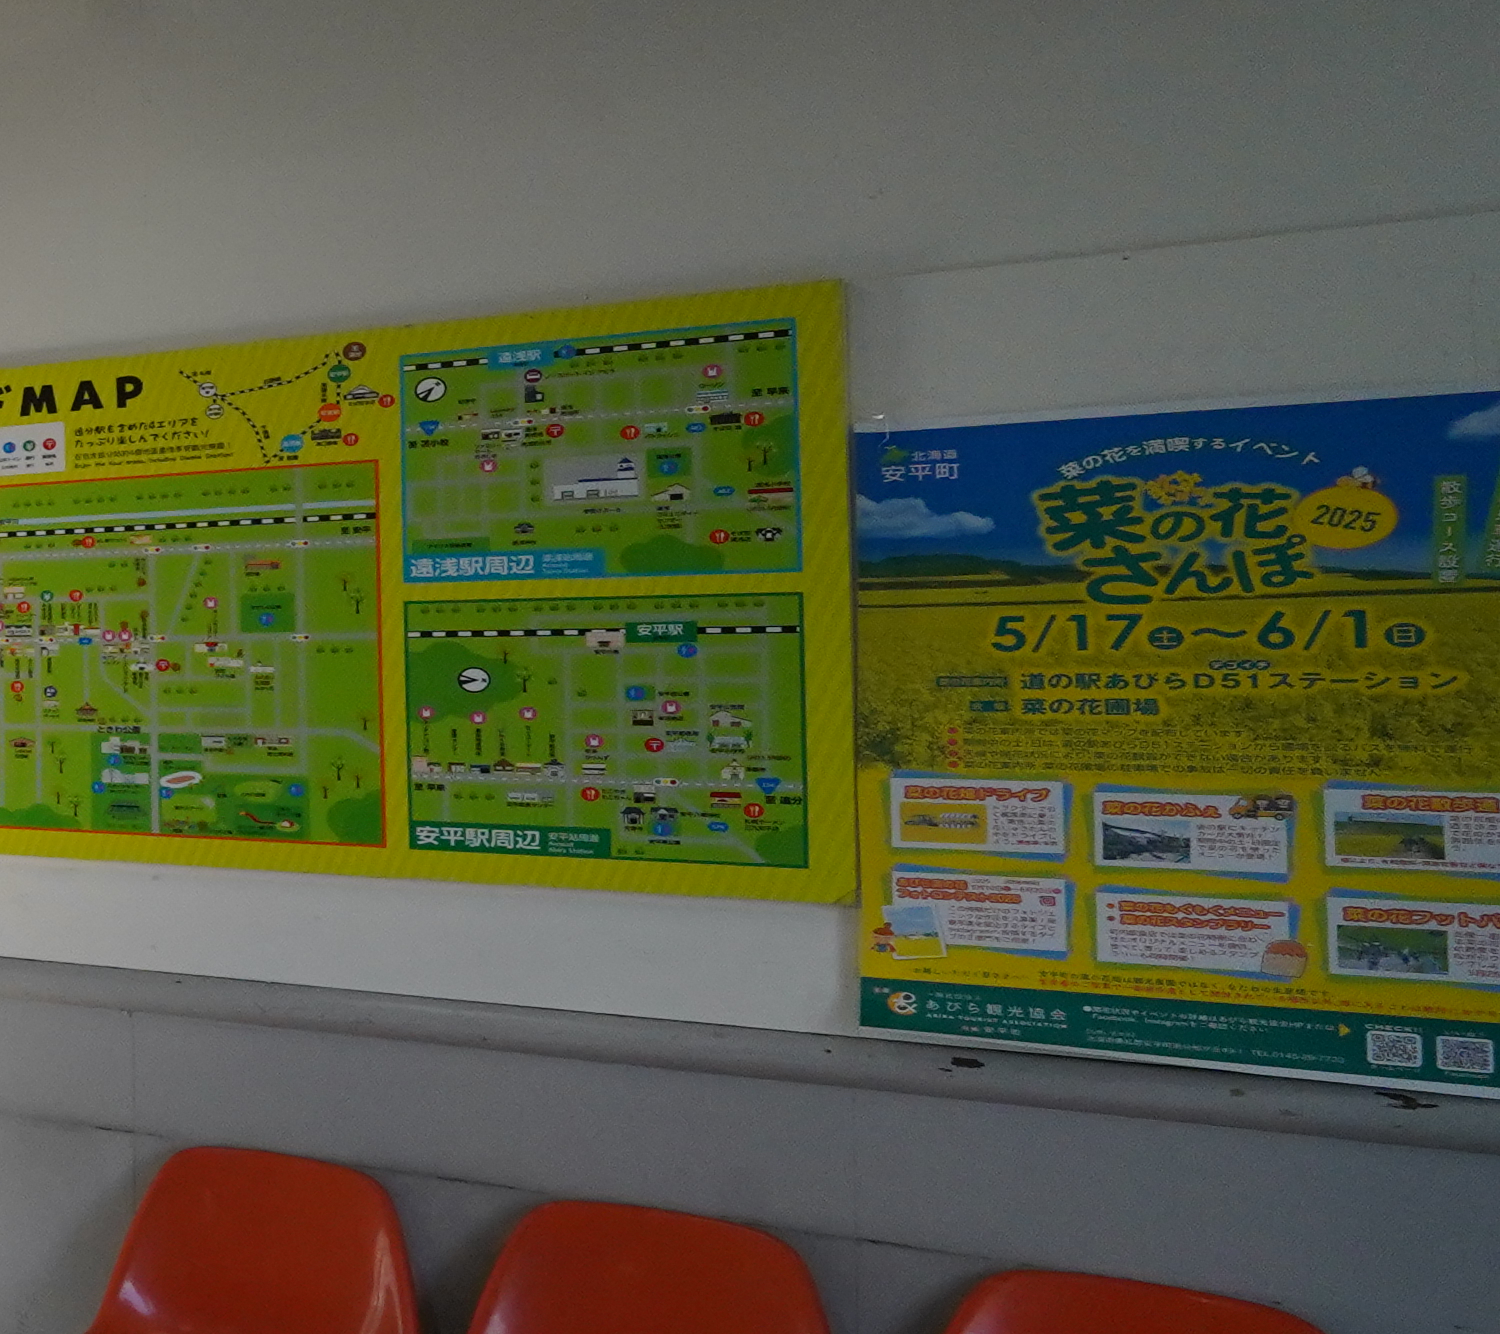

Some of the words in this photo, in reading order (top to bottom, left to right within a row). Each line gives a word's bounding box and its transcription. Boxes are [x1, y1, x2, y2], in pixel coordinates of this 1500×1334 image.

[497, 348, 542, 364] 遠浅駅
[911, 449, 957, 462] 北海道
[1058, 436, 1320, 481] 菜の花を満喫するイベント
[881, 463, 960, 483] 安平町
[1036, 479, 1294, 553] 菜の花
[1311, 504, 1381, 532] 2025
[1438, 480, 1463, 583] 散歩コース設置
[410, 555, 535, 578] 遠浅駅周辺
[1083, 532, 1316, 606] さんぽ
[636, 624, 684, 636] 安平駅
[1020, 670, 1460, 692] 道の駅あびらD51ステーション
[1102, 800, 1223, 819] 菜の花かふぇ
[416, 825, 541, 850] 安平駅周辺
[925, 999, 1067, 1021] あびら観光協会
